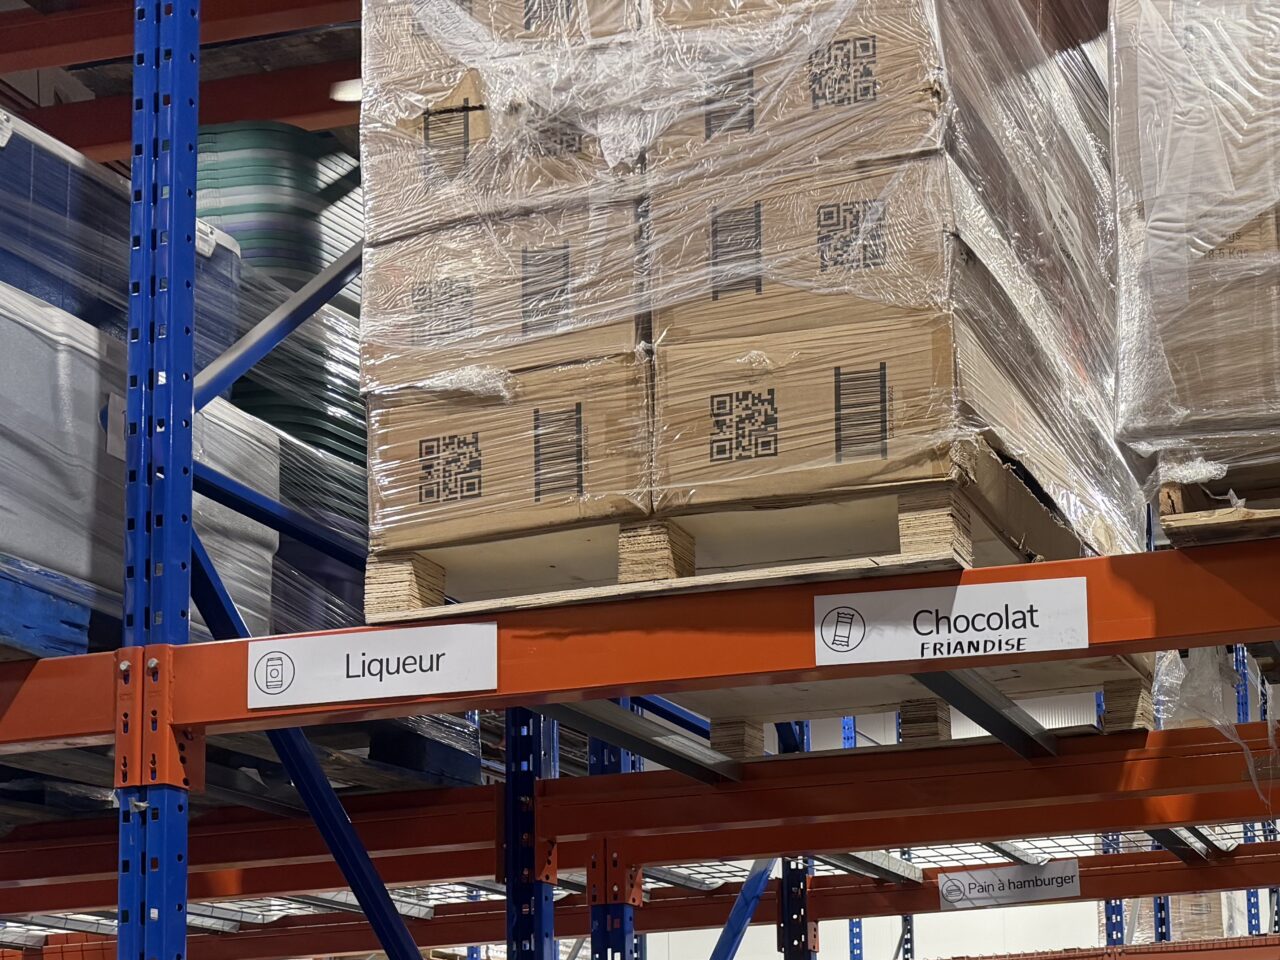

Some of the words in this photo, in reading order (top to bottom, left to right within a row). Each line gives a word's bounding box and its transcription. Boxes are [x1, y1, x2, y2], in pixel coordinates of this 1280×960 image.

[912, 604, 1040, 637] Chocolat
[345, 650, 446, 682] Liqueur
[968, 882, 995, 894] Pain
[998, 879, 1006, 892] à
[1007, 874, 1076, 890] hamburger
